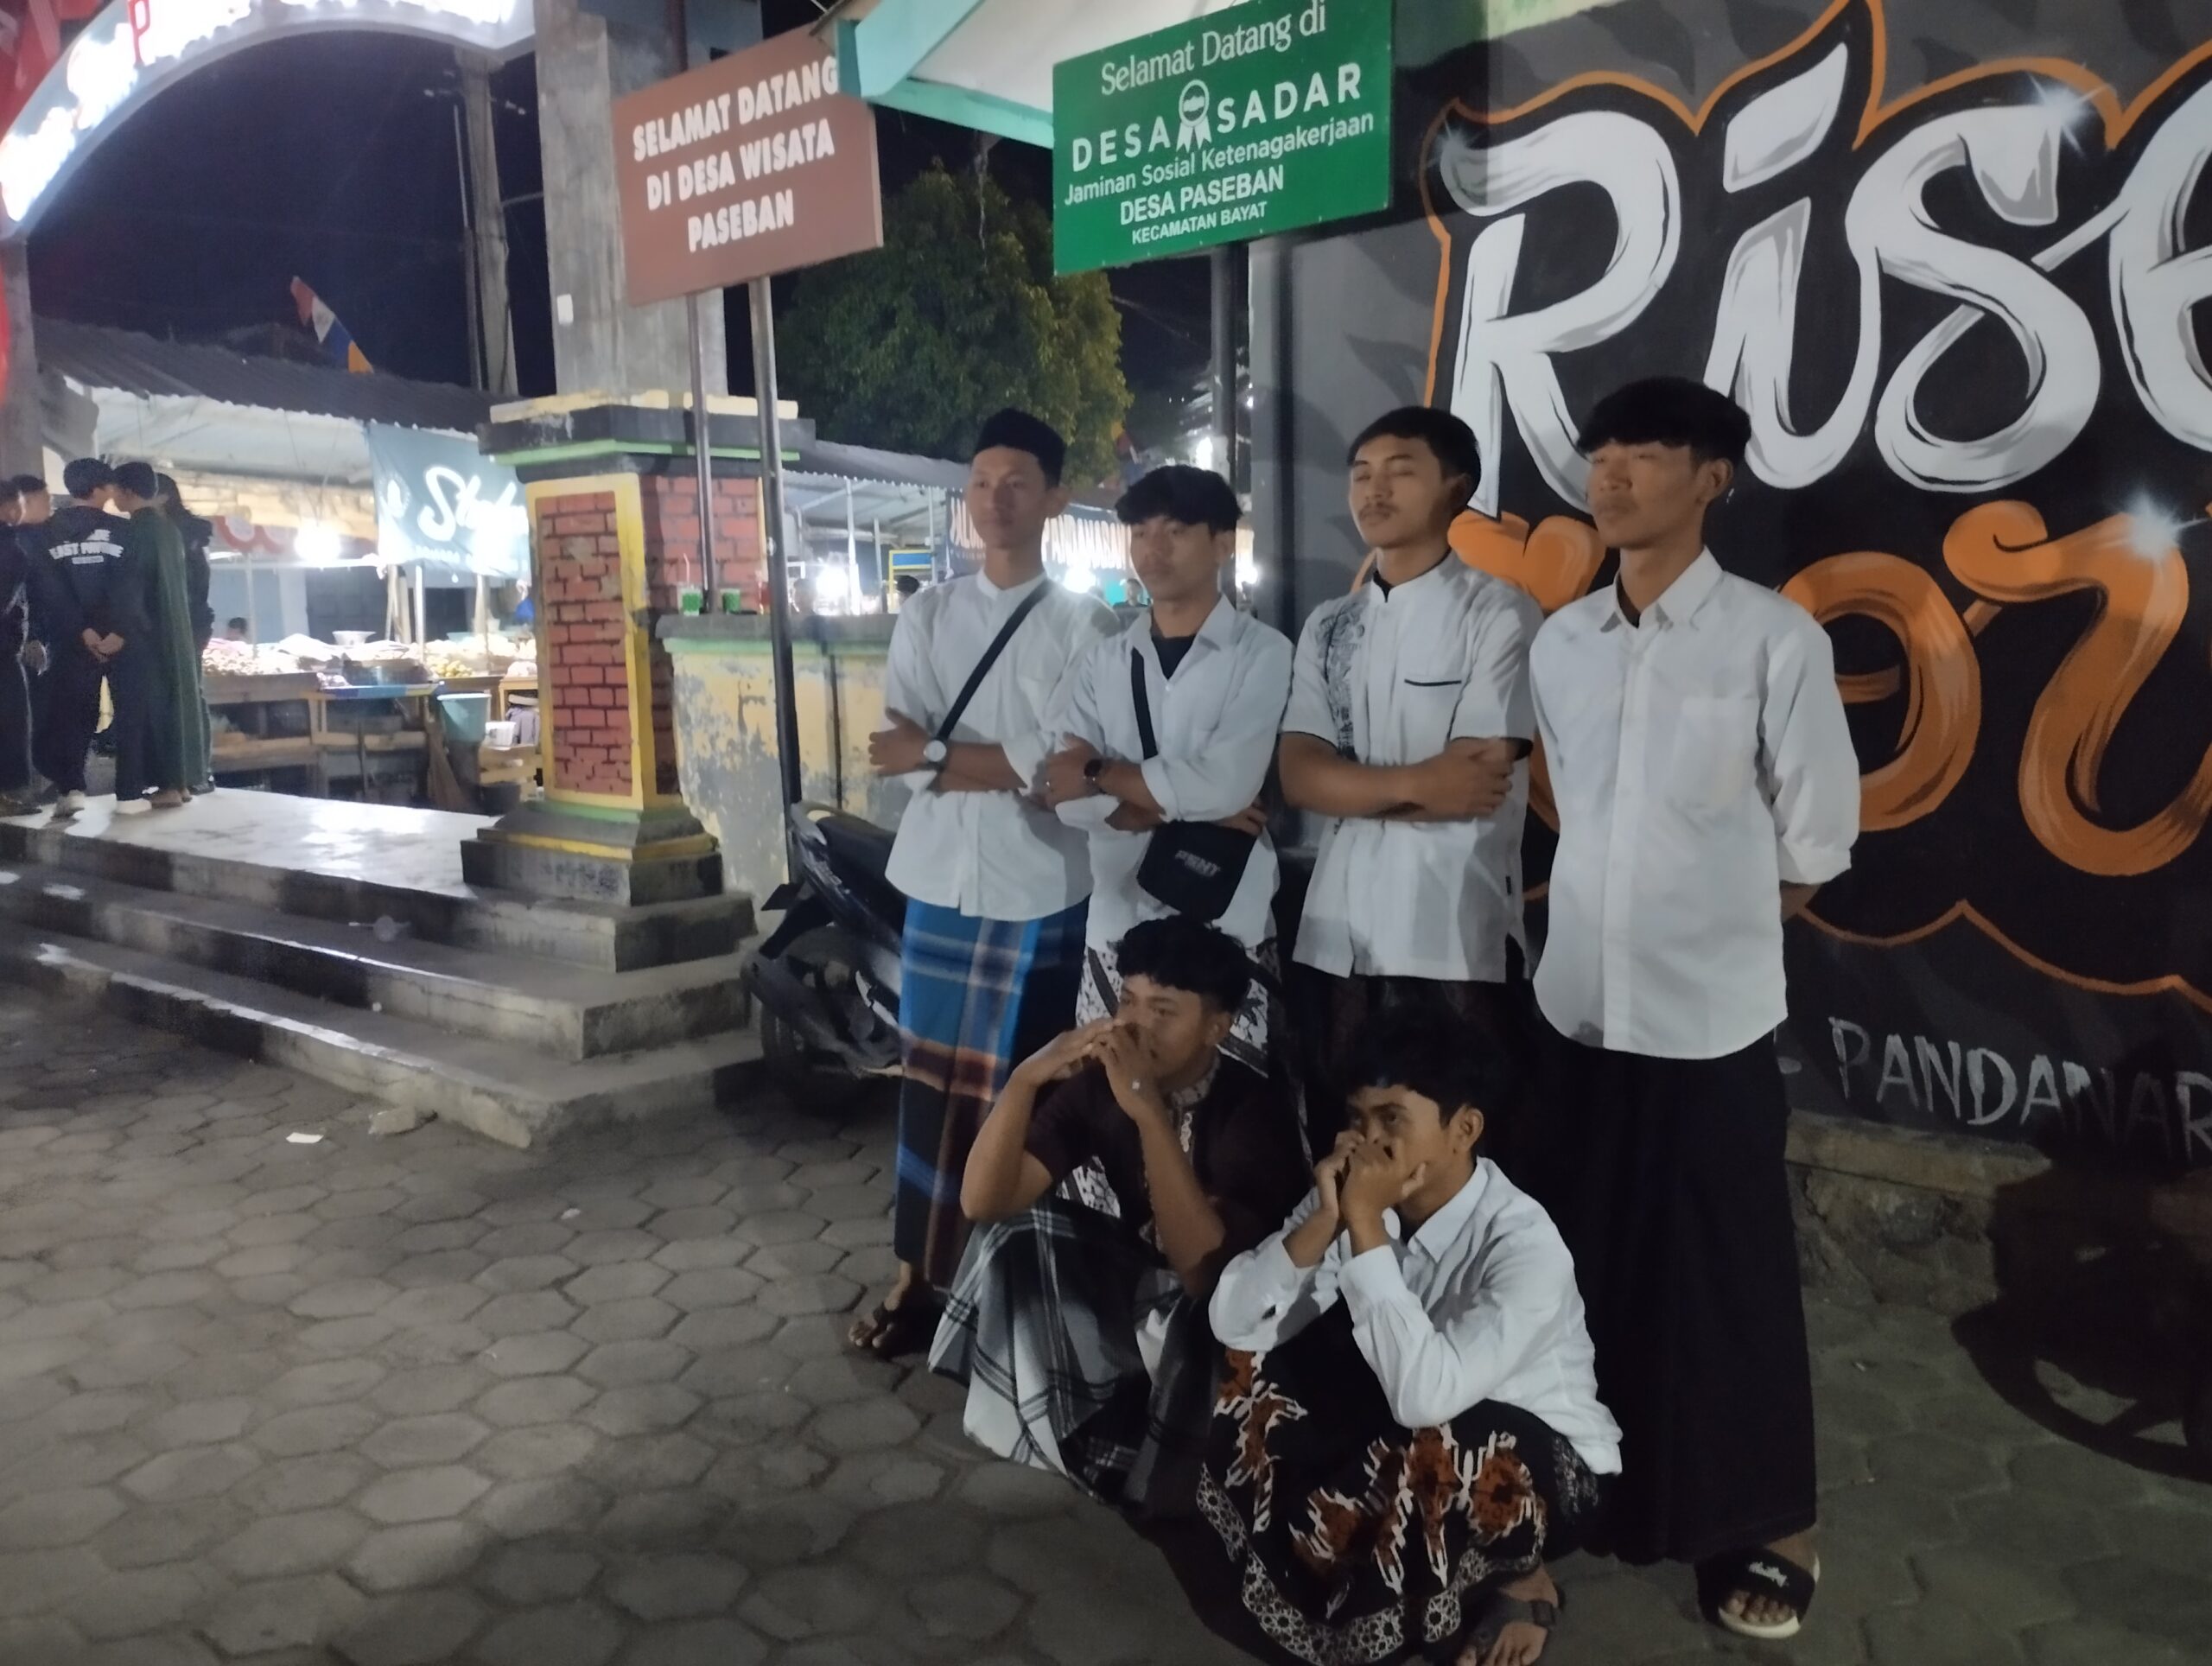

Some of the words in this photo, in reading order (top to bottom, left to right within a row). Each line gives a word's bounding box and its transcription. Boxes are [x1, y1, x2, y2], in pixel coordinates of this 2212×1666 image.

[1101, 41, 1195, 96] Selamat
[1202, 14, 1292, 67] Datang
[1299, 0, 1326, 36] di
[632, 93, 731, 162] SELAMAT
[737, 55, 839, 125] DATANG
[1072, 115, 1171, 172] DESA
[1217, 62, 1361, 133] SADAR
[646, 171, 671, 211] DI
[677, 150, 736, 201] DESA
[740, 118, 836, 181] WISATA
[1064, 172, 1136, 206] Jaminan
[1141, 152, 1195, 187] Sosial
[1202, 111, 1374, 173] Ketenagakerjaan
[1121, 191, 1175, 226] DESA
[1180, 165, 1284, 211] PASEBAN
[687, 188, 795, 252] PASEBAN
[1132, 214, 1217, 245] KECAMATAN
[1220, 201, 1268, 226] BAYAT
